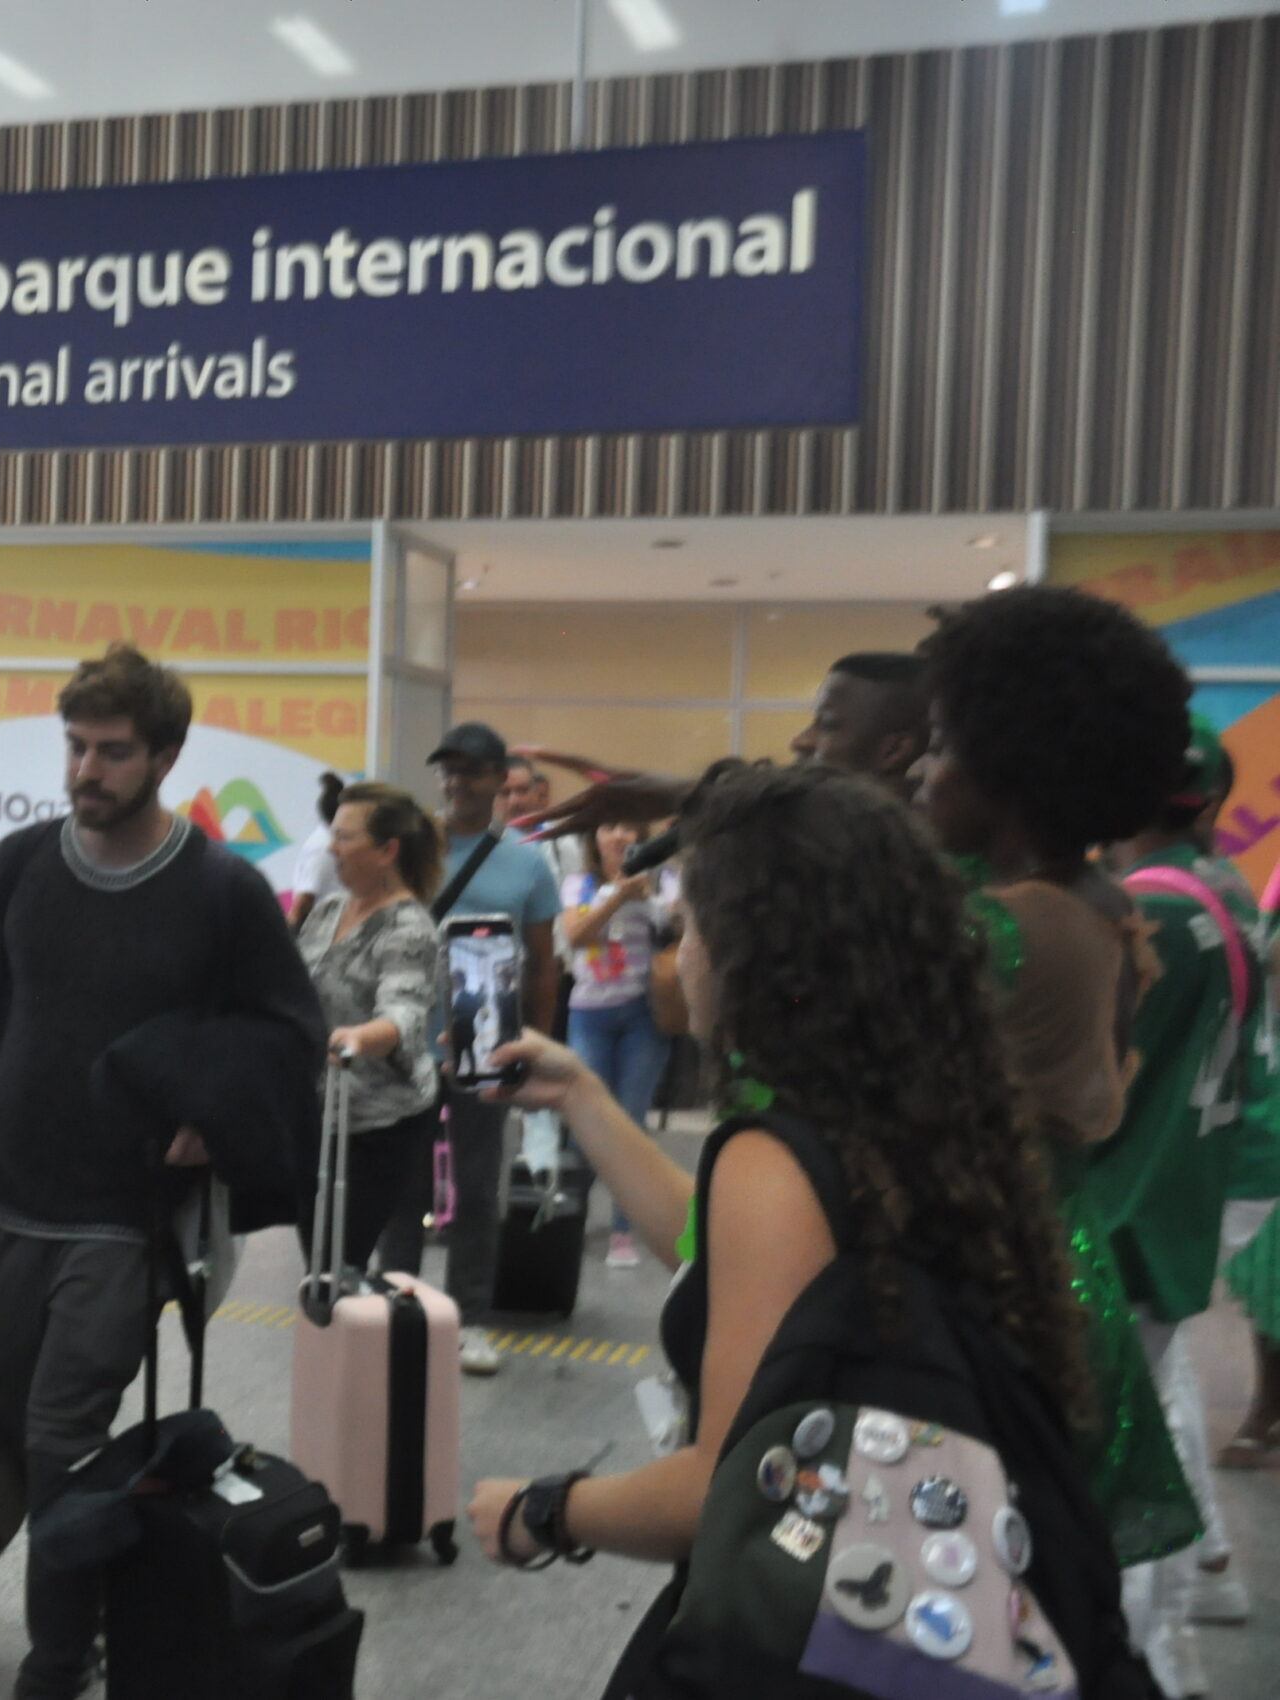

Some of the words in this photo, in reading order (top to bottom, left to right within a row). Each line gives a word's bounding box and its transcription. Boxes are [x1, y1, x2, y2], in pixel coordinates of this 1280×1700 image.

[249, 188, 817, 302] internacional
[81, 337, 296, 404] arrivals
[198, 695, 369, 739] ALEG
